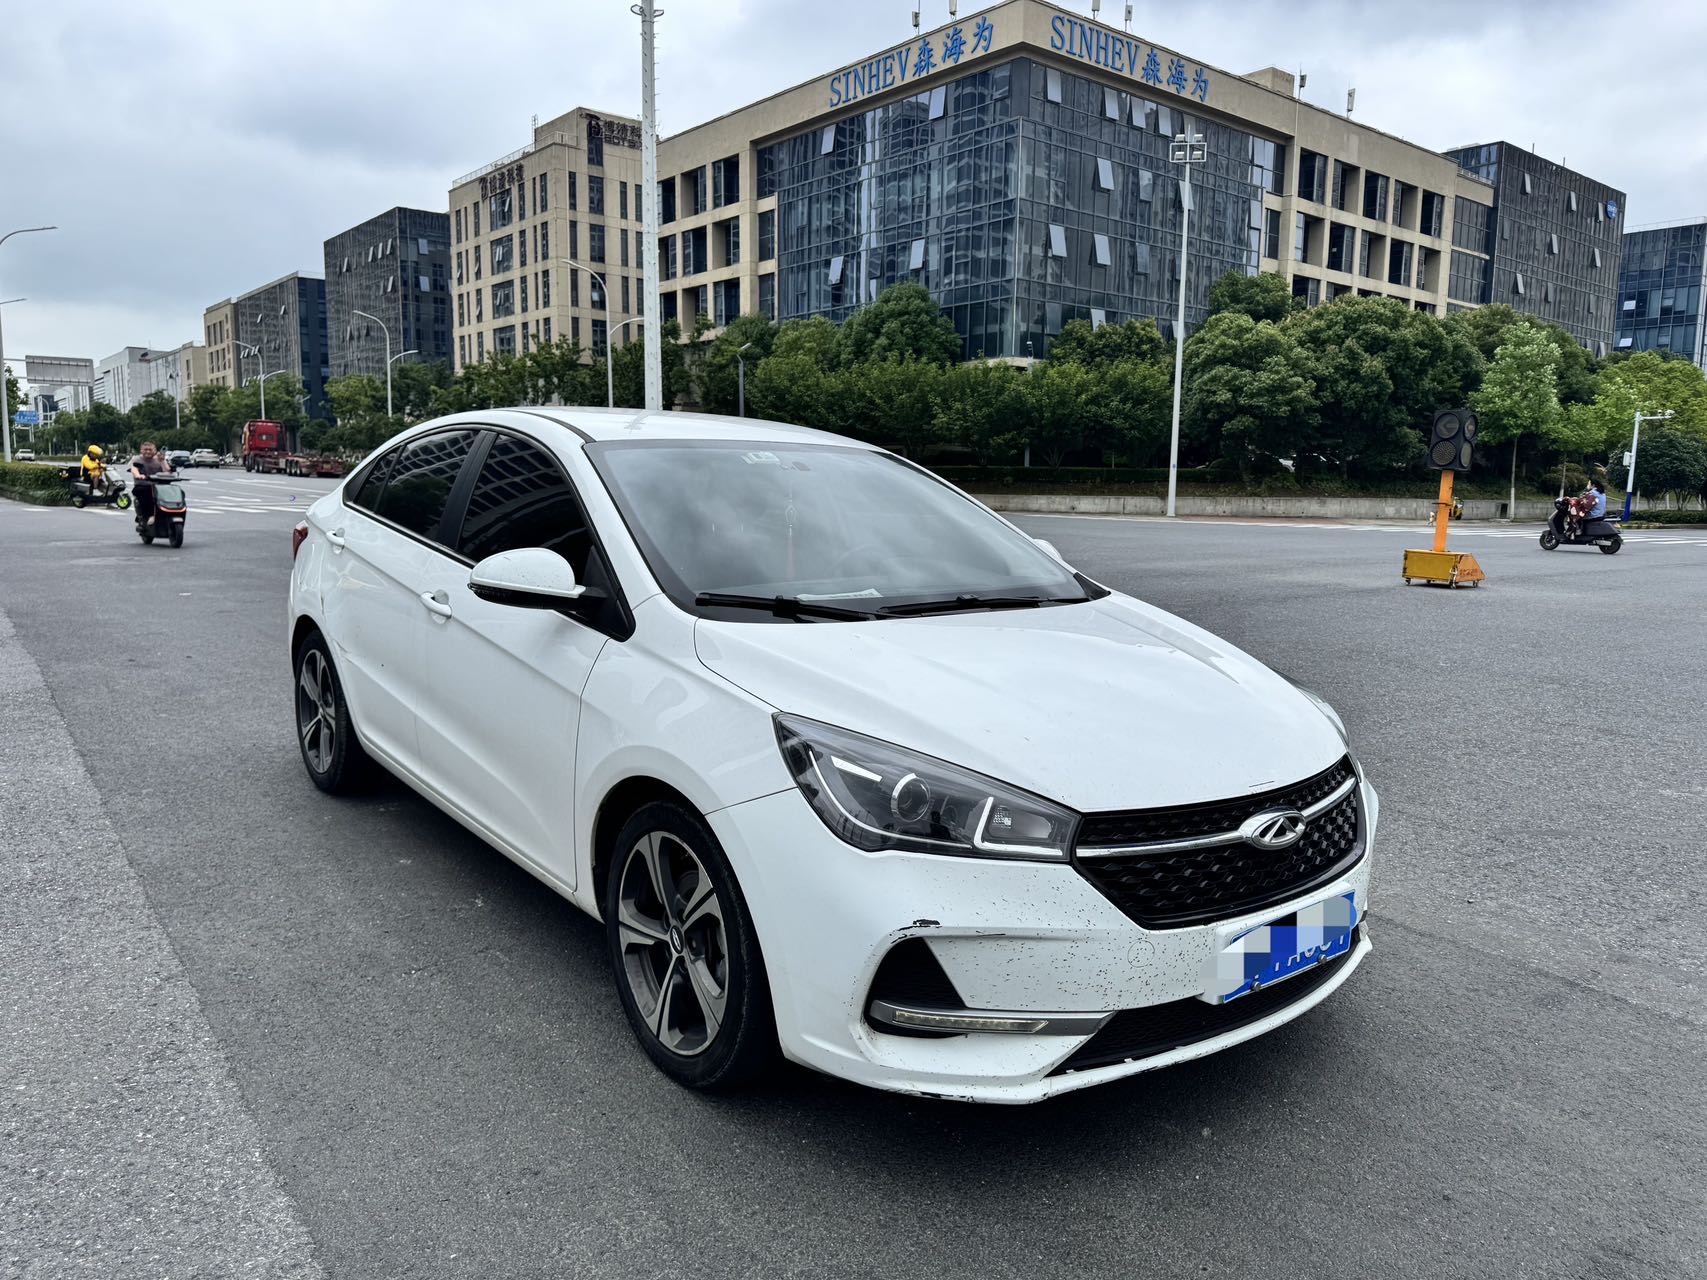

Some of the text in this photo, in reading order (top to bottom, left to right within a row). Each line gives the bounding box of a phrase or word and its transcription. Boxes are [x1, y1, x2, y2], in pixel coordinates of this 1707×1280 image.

[829, 15, 993, 108] SINHEV 森海为
[1050, 15, 1209, 102] SINHEV 森海为
